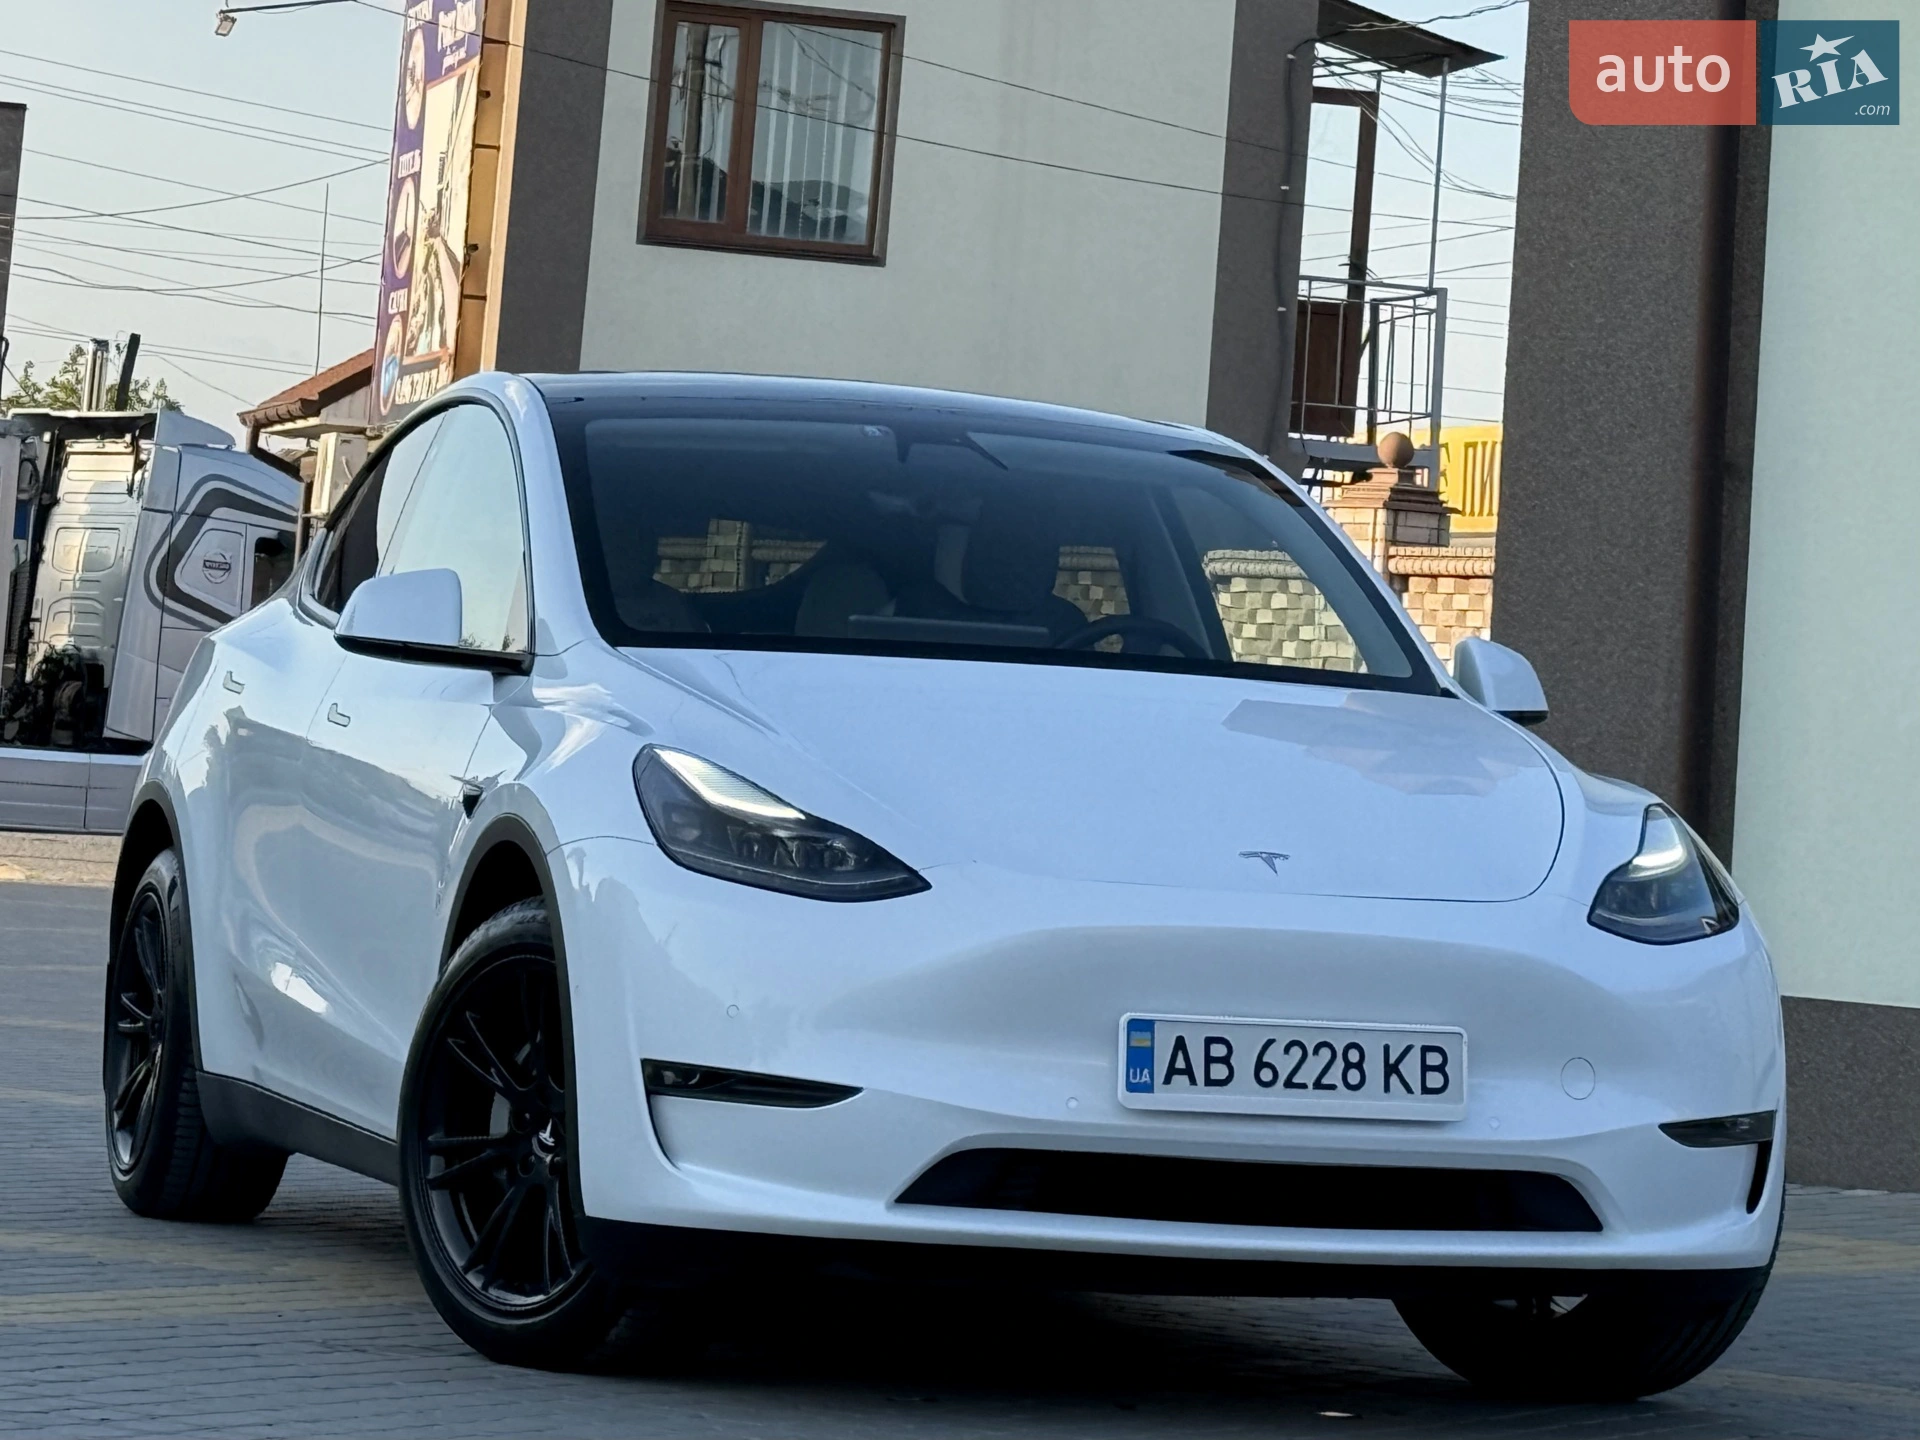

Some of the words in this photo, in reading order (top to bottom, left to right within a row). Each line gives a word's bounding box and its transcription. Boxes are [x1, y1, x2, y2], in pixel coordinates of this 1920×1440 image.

[1130, 1068, 1150, 1084] UA
[1162, 1035, 1235, 1088] AB
[1253, 1038, 1367, 1091] 6228
[1383, 1043, 1450, 1095] KB
